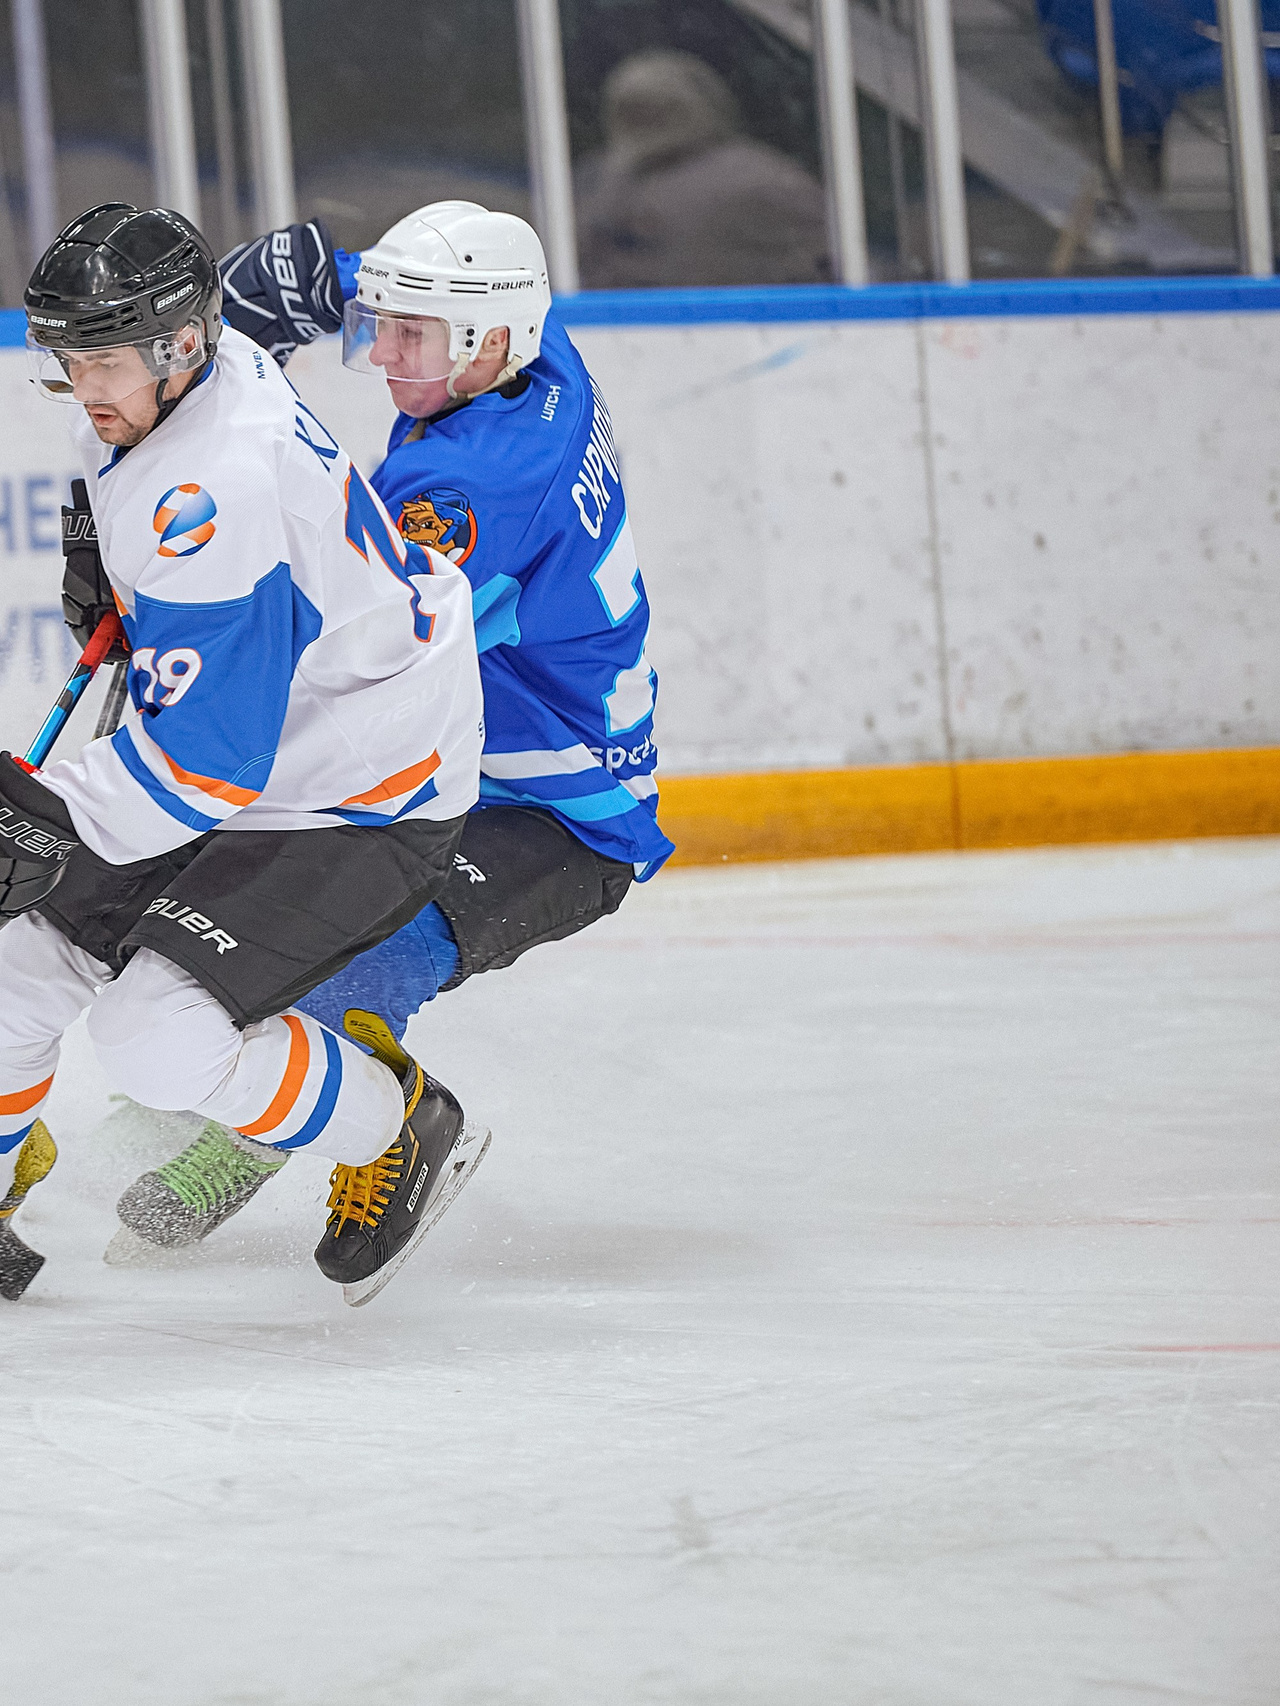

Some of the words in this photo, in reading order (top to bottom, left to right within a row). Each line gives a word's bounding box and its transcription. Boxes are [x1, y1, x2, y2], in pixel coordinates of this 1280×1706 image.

[156, 283, 194, 310] BAUER
[272, 232, 326, 341] BAUE
[491, 279, 534, 291] BAUER
[30, 315, 67, 328] BAUER
[541, 385, 561, 422] LUTCH
[142, 898, 239, 955] AUER
